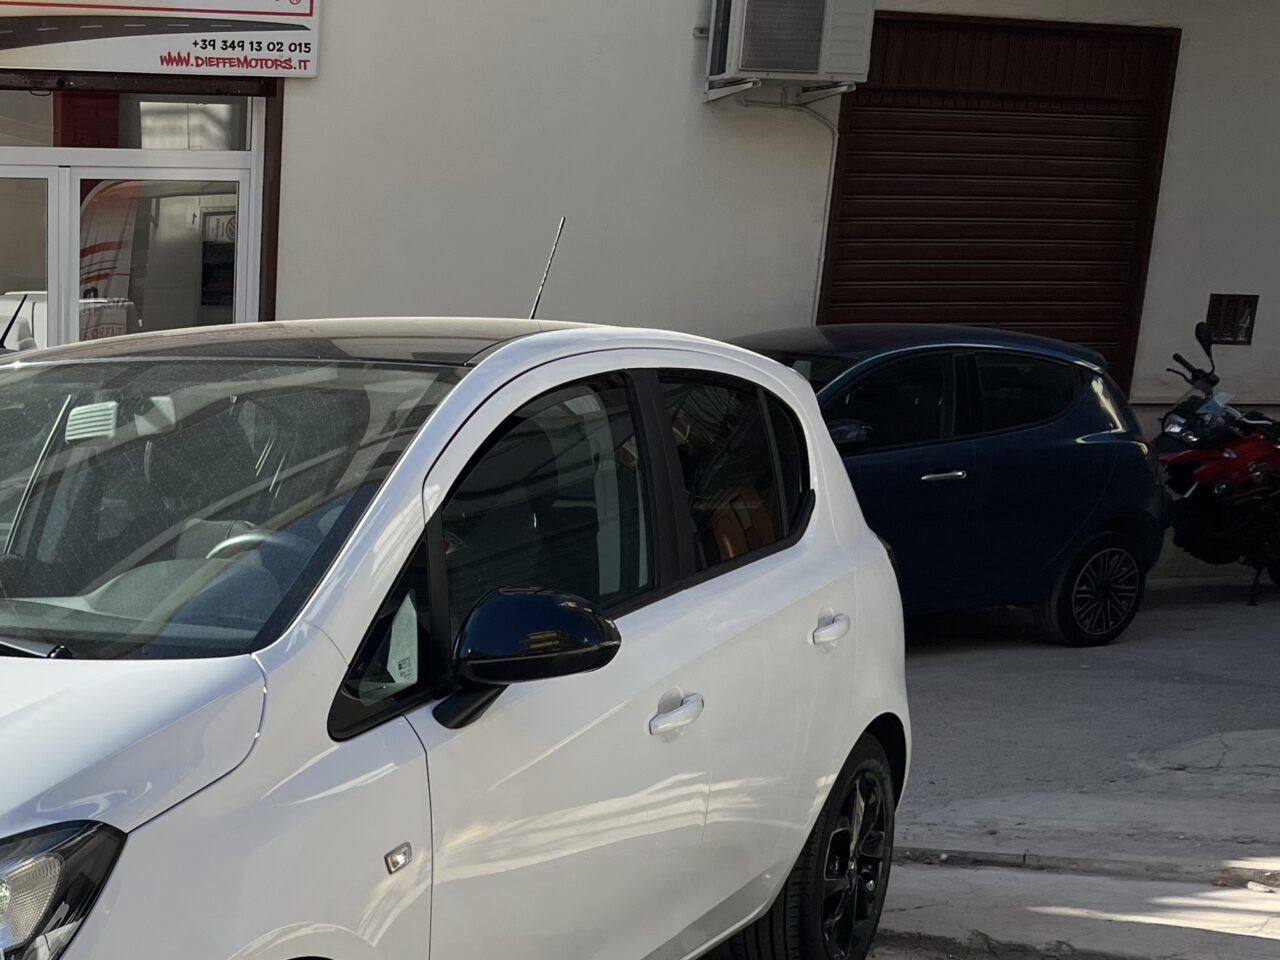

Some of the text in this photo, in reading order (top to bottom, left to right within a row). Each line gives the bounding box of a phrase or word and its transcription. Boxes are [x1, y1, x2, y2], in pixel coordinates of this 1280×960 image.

[192, 39, 312, 54] +39 349 13 02 015
[159, 51, 311, 71] WWW.DIEFFEMOTORS.IT
